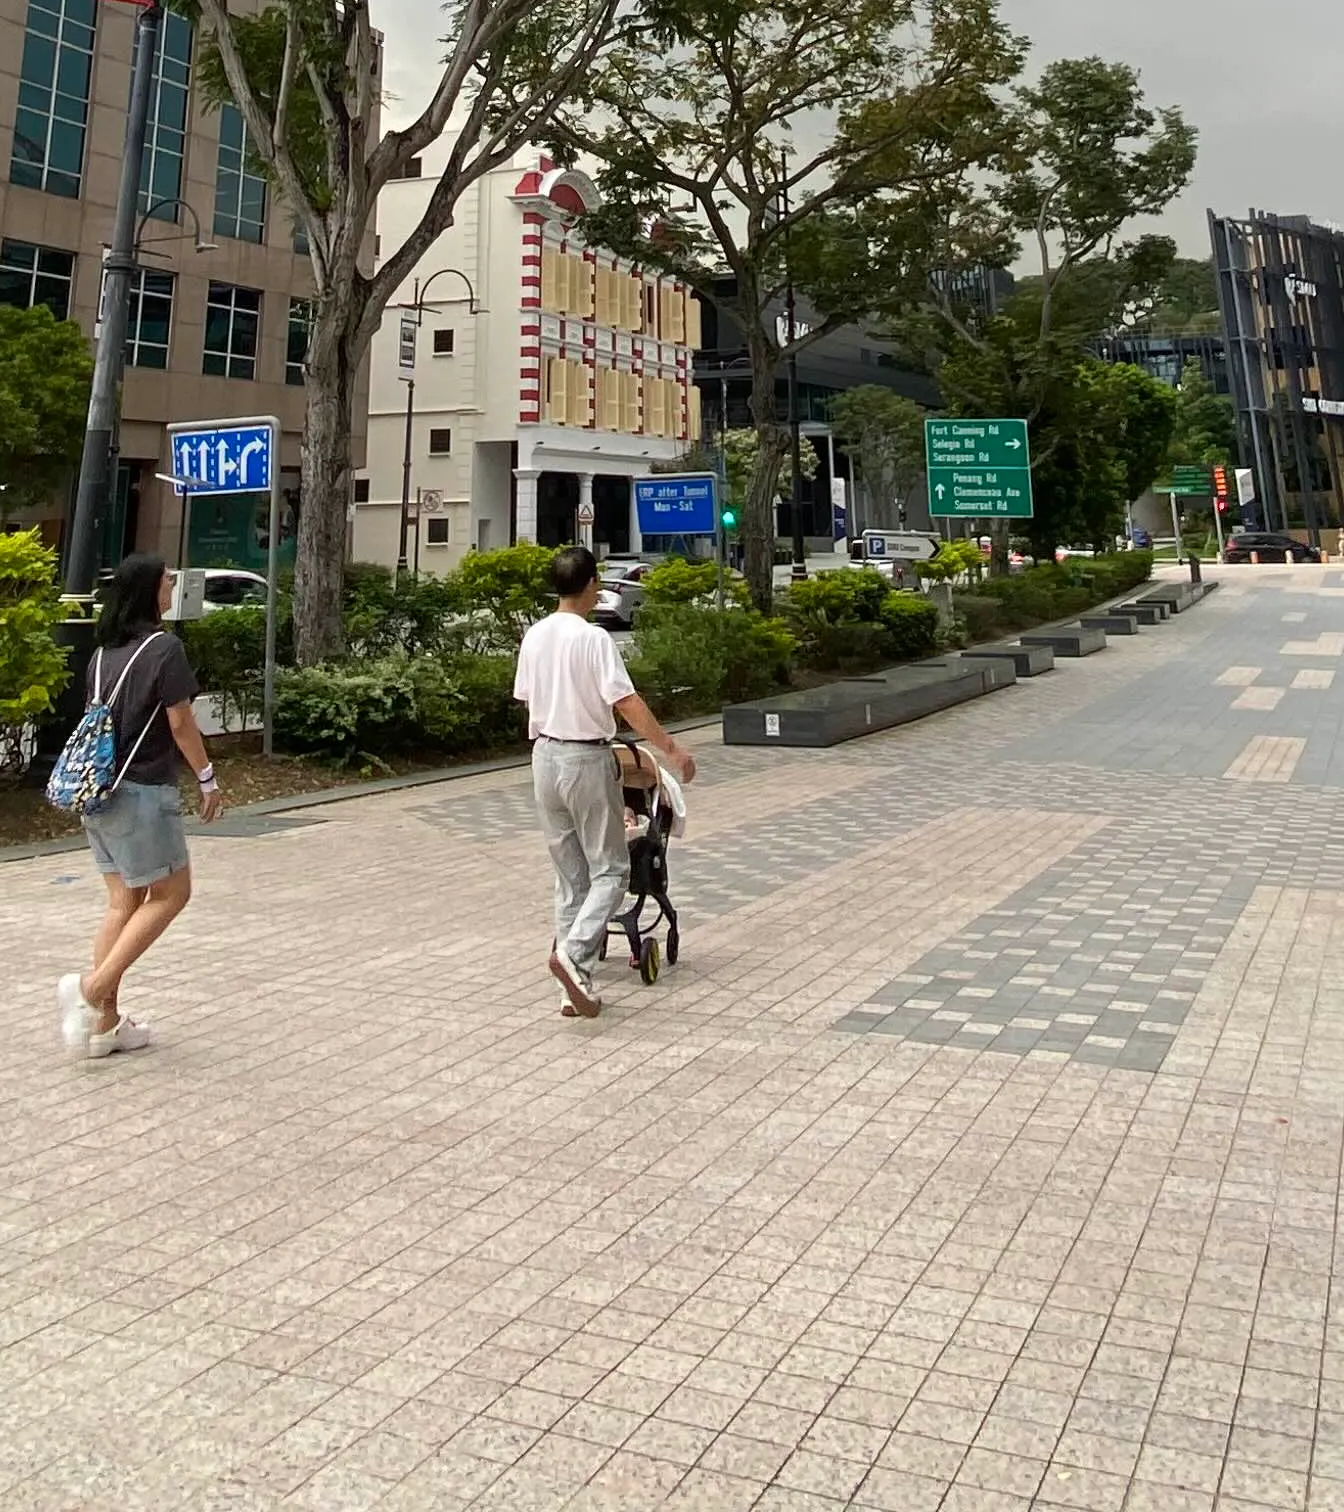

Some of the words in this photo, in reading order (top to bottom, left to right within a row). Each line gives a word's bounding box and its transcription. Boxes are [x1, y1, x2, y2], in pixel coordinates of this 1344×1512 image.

[931, 425, 948, 435] Fort
[952, 425, 985, 438] Canning
[989, 424, 1000, 435] Rd
[964, 438, 975, 449] Rd
[978, 451, 990, 462] Rd
[953, 472, 983, 485] Penang
[986, 472, 997, 483] Rd
[639, 487, 654, 497] ERP
[658, 486, 678, 497] after
[683, 485, 708, 497] Tunnel
[1006, 487, 1021, 497] Ave
[654, 501, 671, 512] Mon
[679, 500, 694, 511] Sat
[955, 499, 993, 510] Somerset
[997, 500, 1008, 511] Rd
